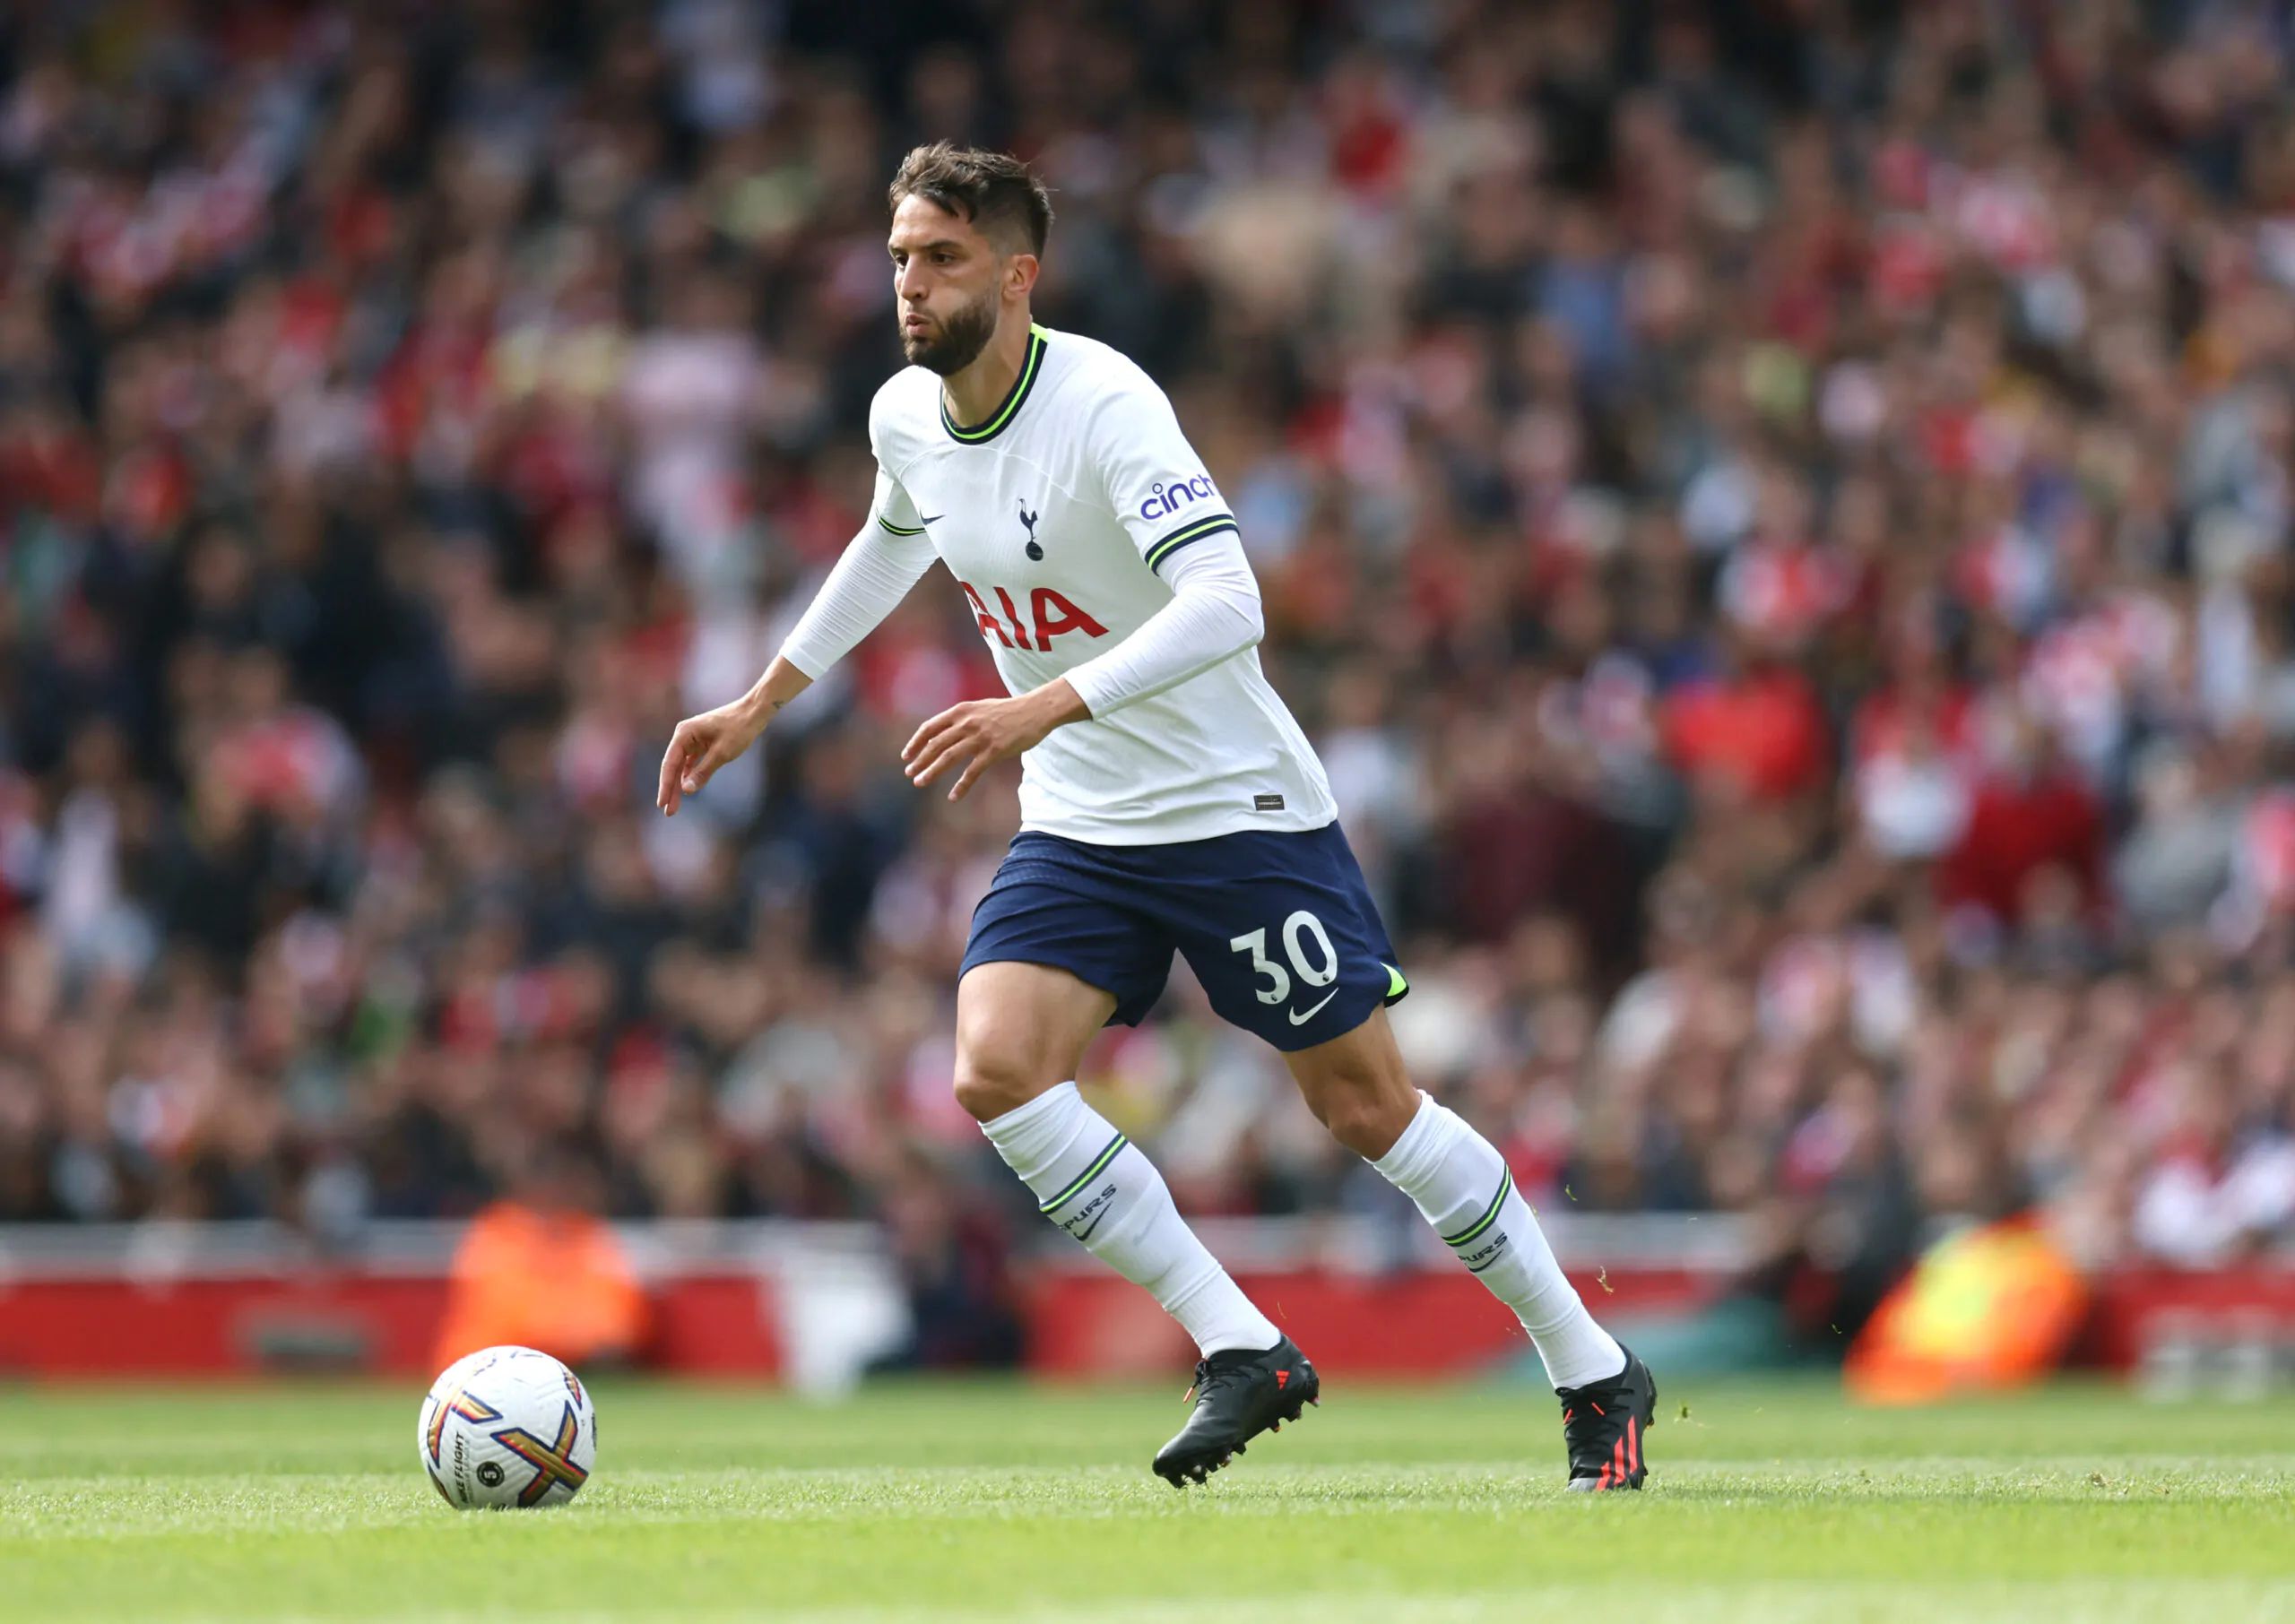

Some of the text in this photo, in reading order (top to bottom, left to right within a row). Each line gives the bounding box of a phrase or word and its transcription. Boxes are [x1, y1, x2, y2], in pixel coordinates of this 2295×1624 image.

[1140, 474, 1215, 520] cinch
[959, 581, 1110, 652] AIA
[1229, 910, 1338, 1005] 30
[454, 1431, 464, 1480] FLIGHT
[484, 1471, 498, 1479] 5
